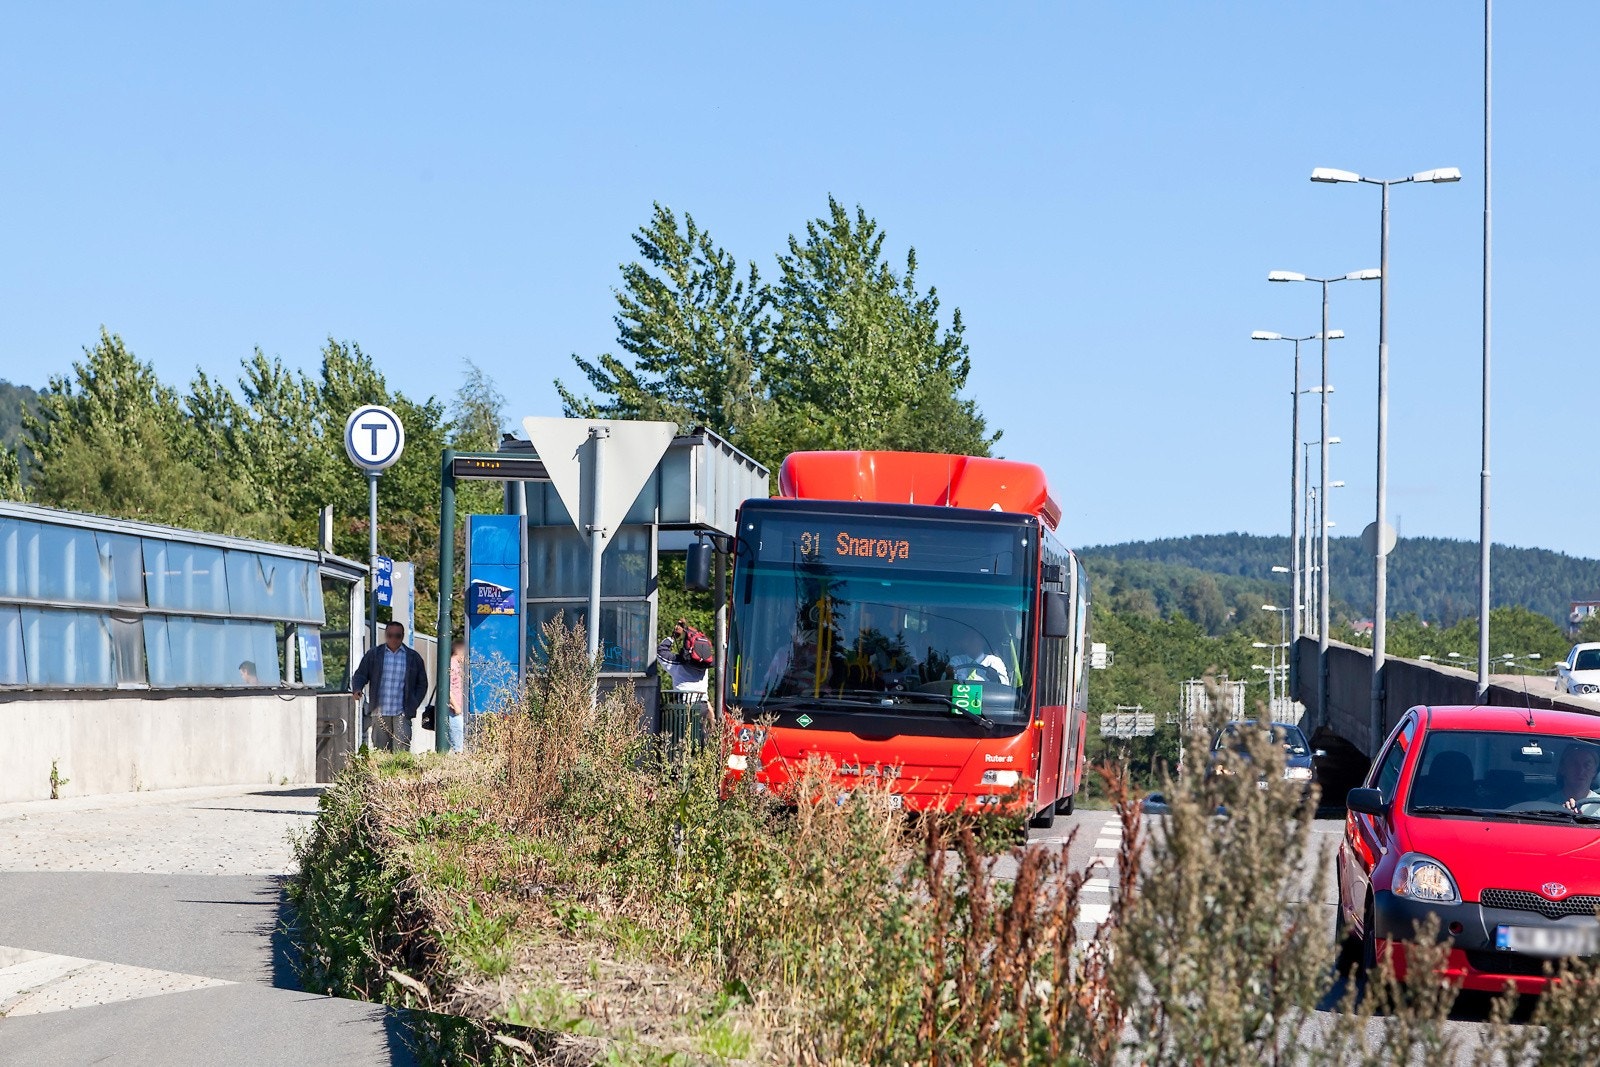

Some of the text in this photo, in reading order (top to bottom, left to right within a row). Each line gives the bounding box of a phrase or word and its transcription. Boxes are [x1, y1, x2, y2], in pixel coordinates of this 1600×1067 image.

[361, 424, 387, 455] T
[801, 532, 909, 562] 31 Snarøya
